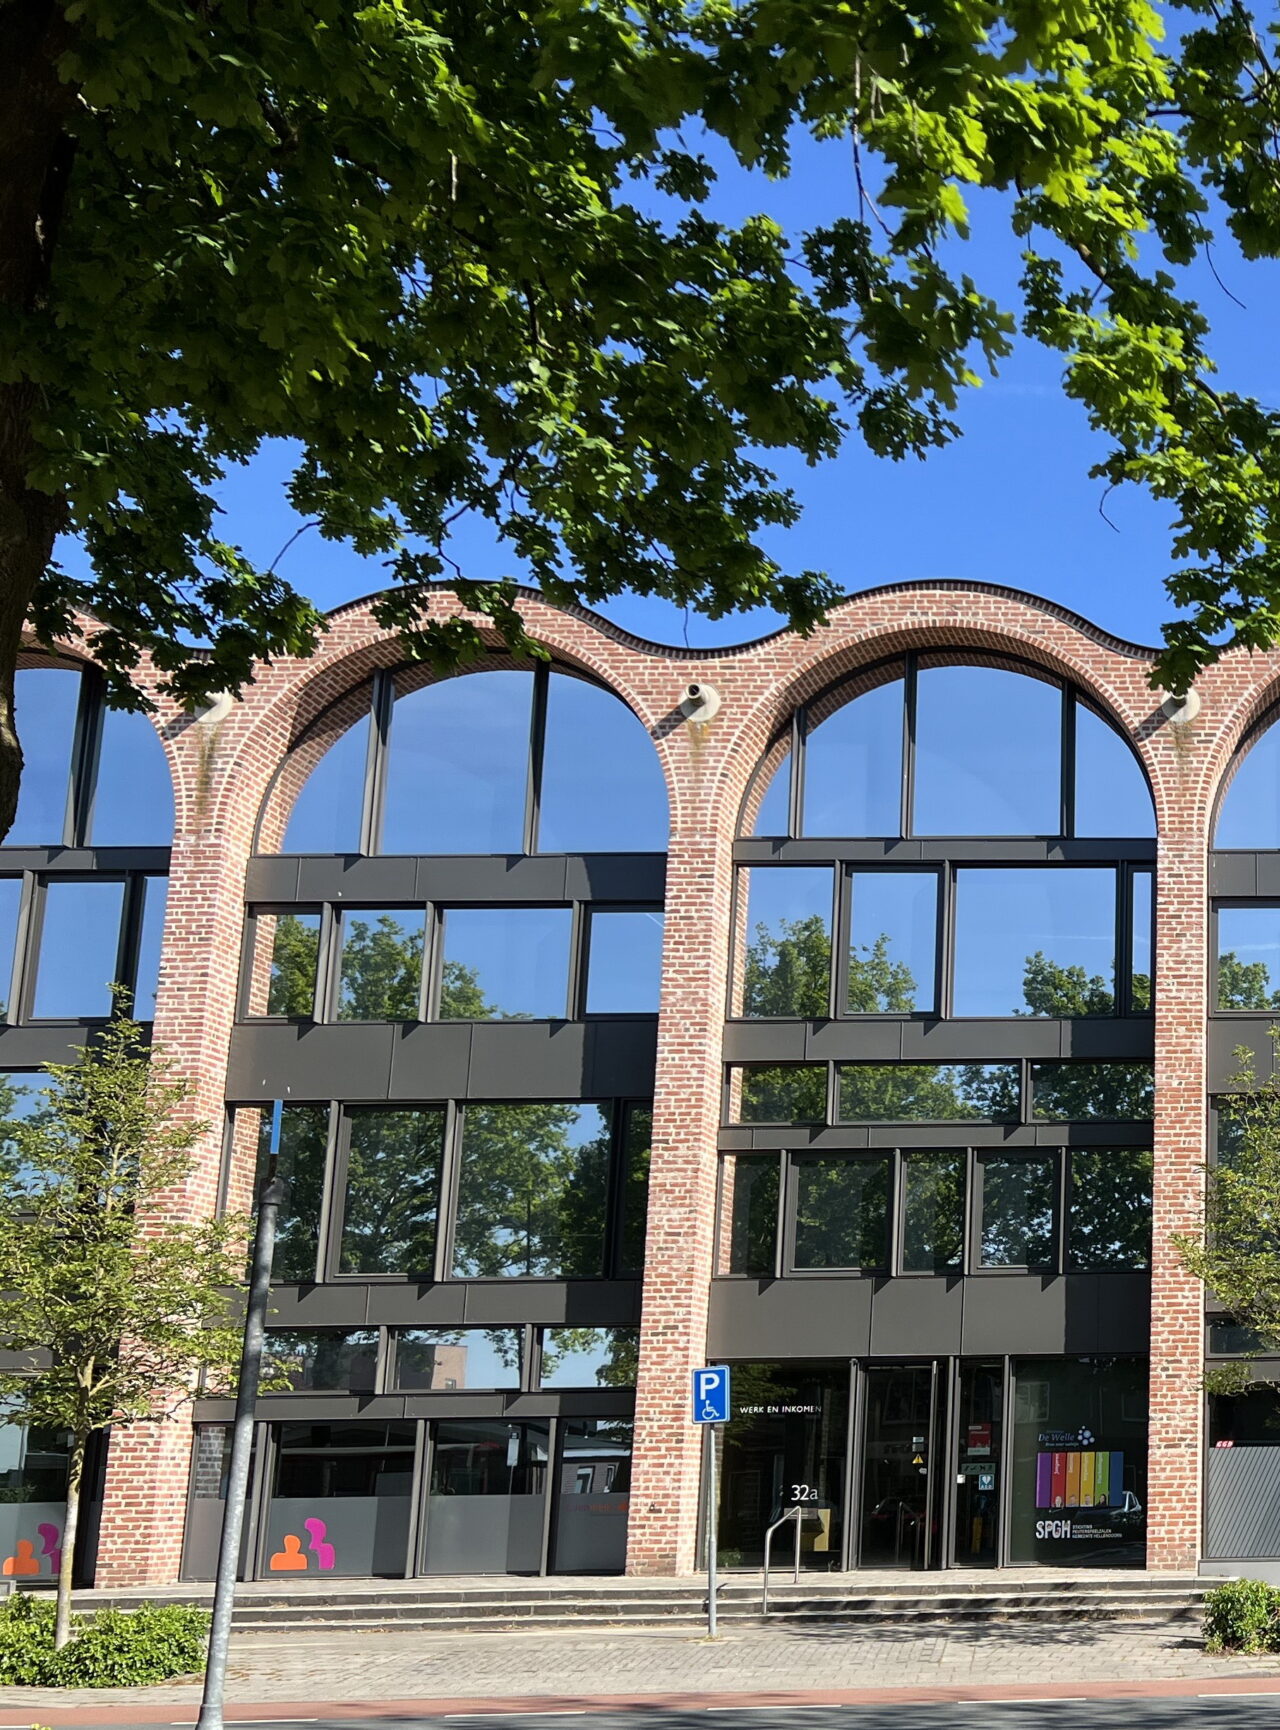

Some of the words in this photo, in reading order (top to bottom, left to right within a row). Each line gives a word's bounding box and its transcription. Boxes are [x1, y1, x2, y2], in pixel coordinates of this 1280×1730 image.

[700, 1373, 720, 1400] P
[740, 1406, 764, 1414] WERK
[782, 1405, 822, 1413] INKOMEN
[1038, 1433, 1049, 1442] De
[1051, 1433, 1075, 1441] Welle
[1215, 1440, 1234, 1448] GGD
[790, 1484, 819, 1500] 32a
[1035, 1520, 1071, 1539] SPGH
